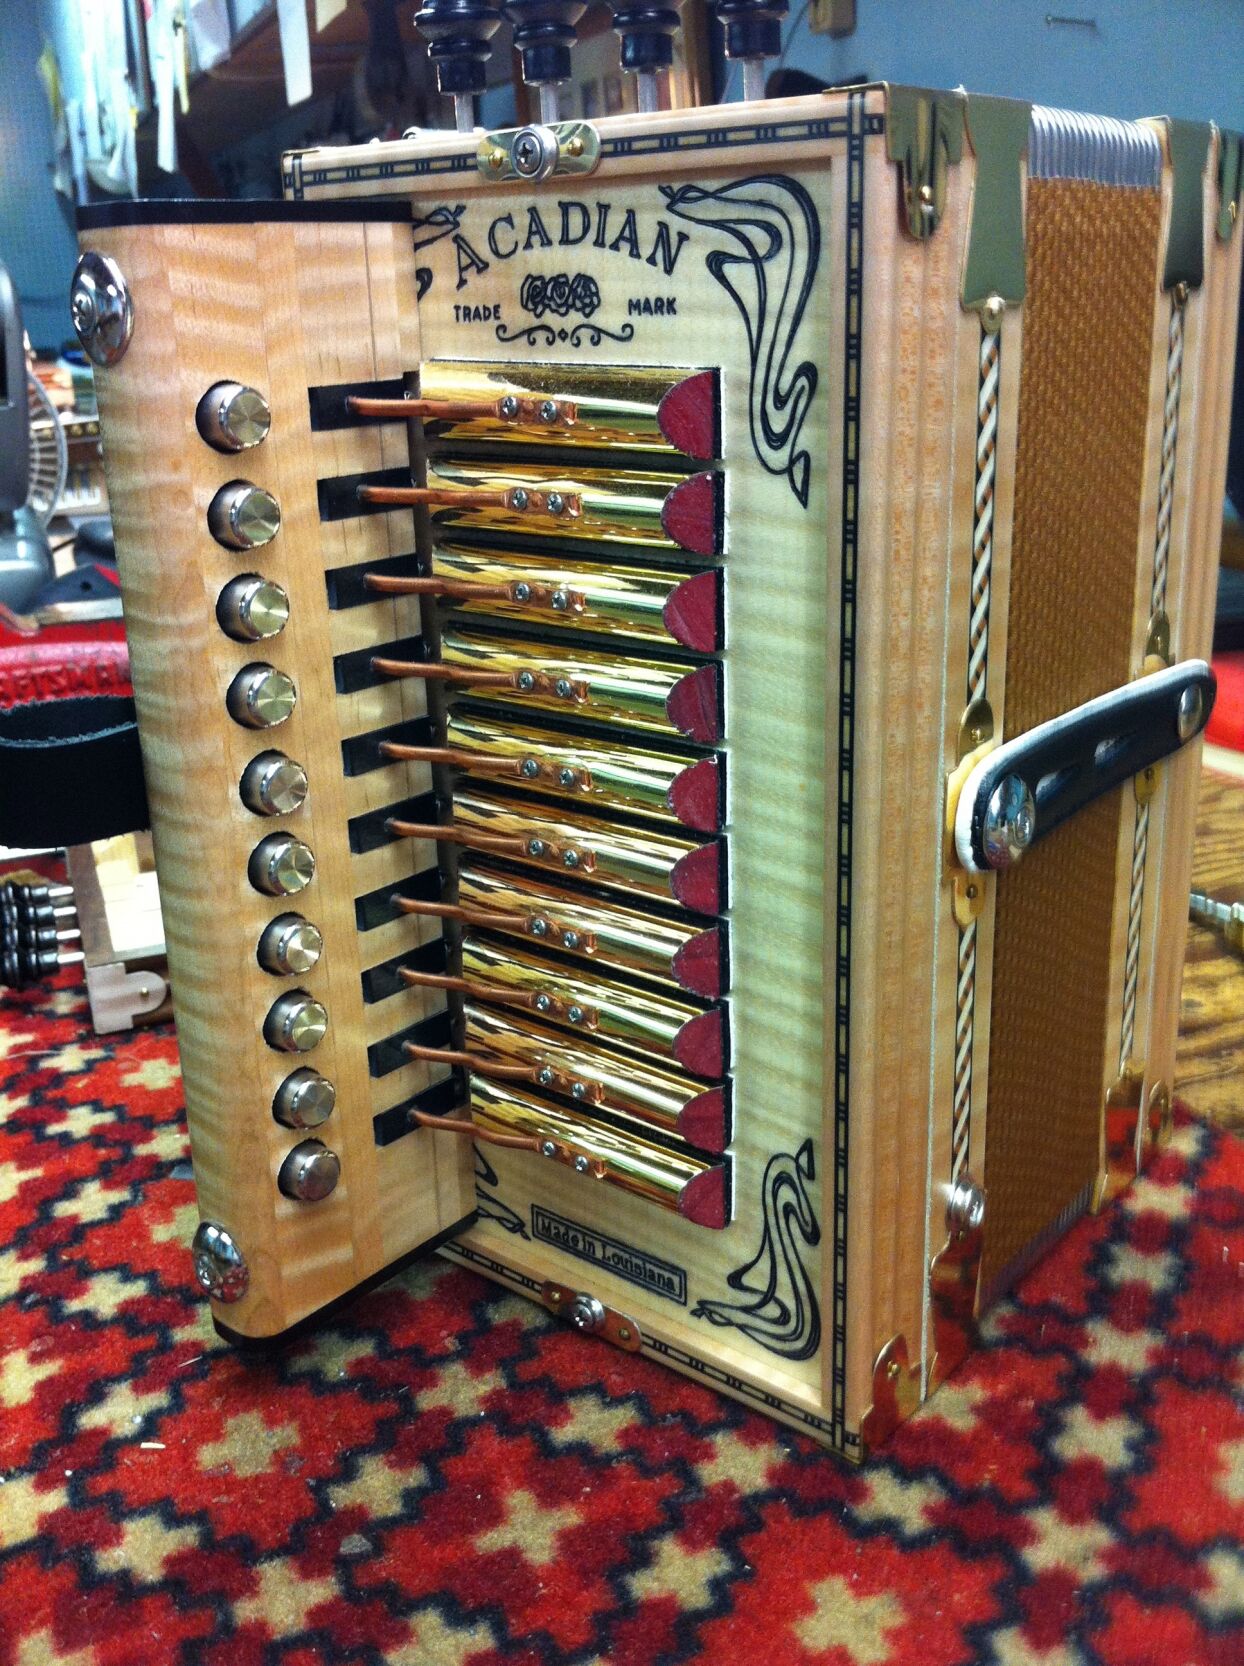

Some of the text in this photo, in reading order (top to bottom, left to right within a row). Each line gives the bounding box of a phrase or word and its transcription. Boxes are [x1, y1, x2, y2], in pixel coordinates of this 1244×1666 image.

[452, 201, 689, 291] ACADIAN
[454, 296, 677, 323] TRADE MARK
[541, 1217, 676, 1292] Made in Louisiana
